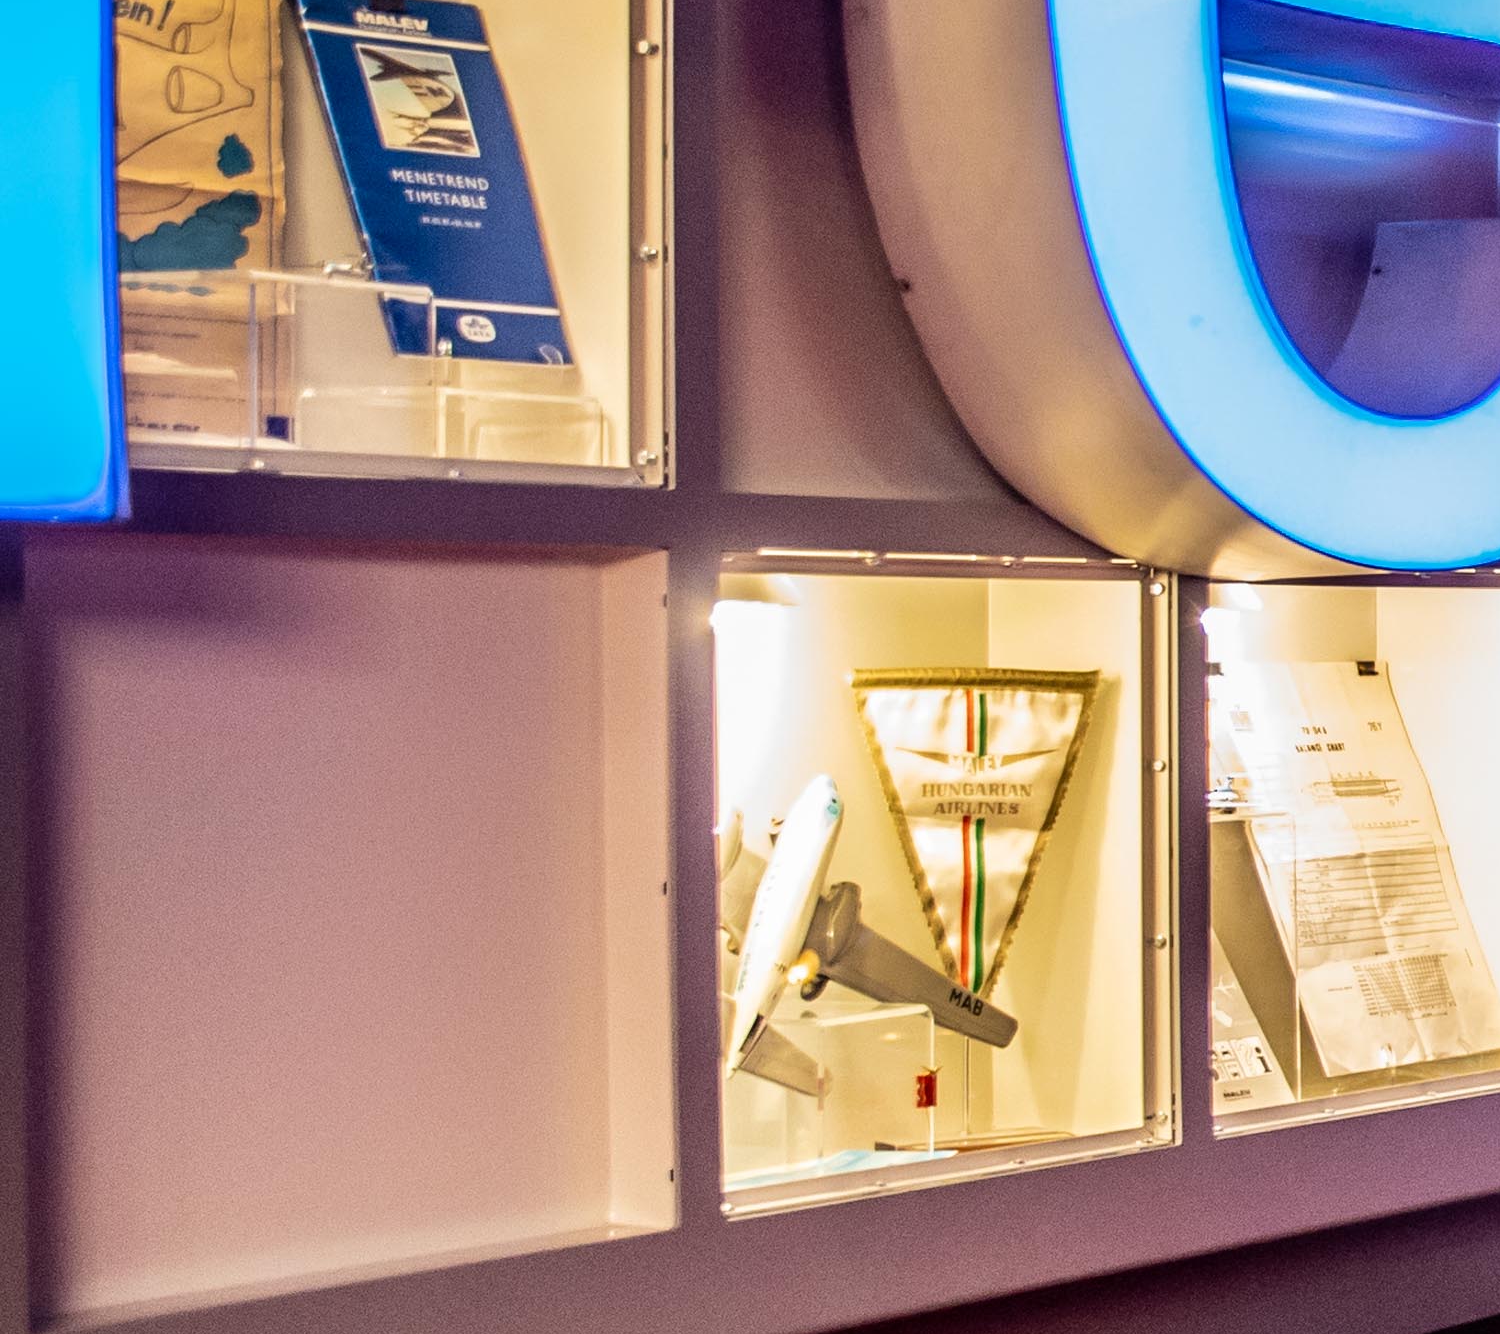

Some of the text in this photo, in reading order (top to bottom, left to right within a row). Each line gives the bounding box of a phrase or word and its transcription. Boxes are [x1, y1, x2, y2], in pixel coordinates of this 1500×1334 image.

[403, 188, 488, 209] TIMETABLE
[920, 782, 1033, 798] HUNGARIAN
[933, 801, 1020, 816] AIRLINES
[948, 987, 985, 1017] MAB
